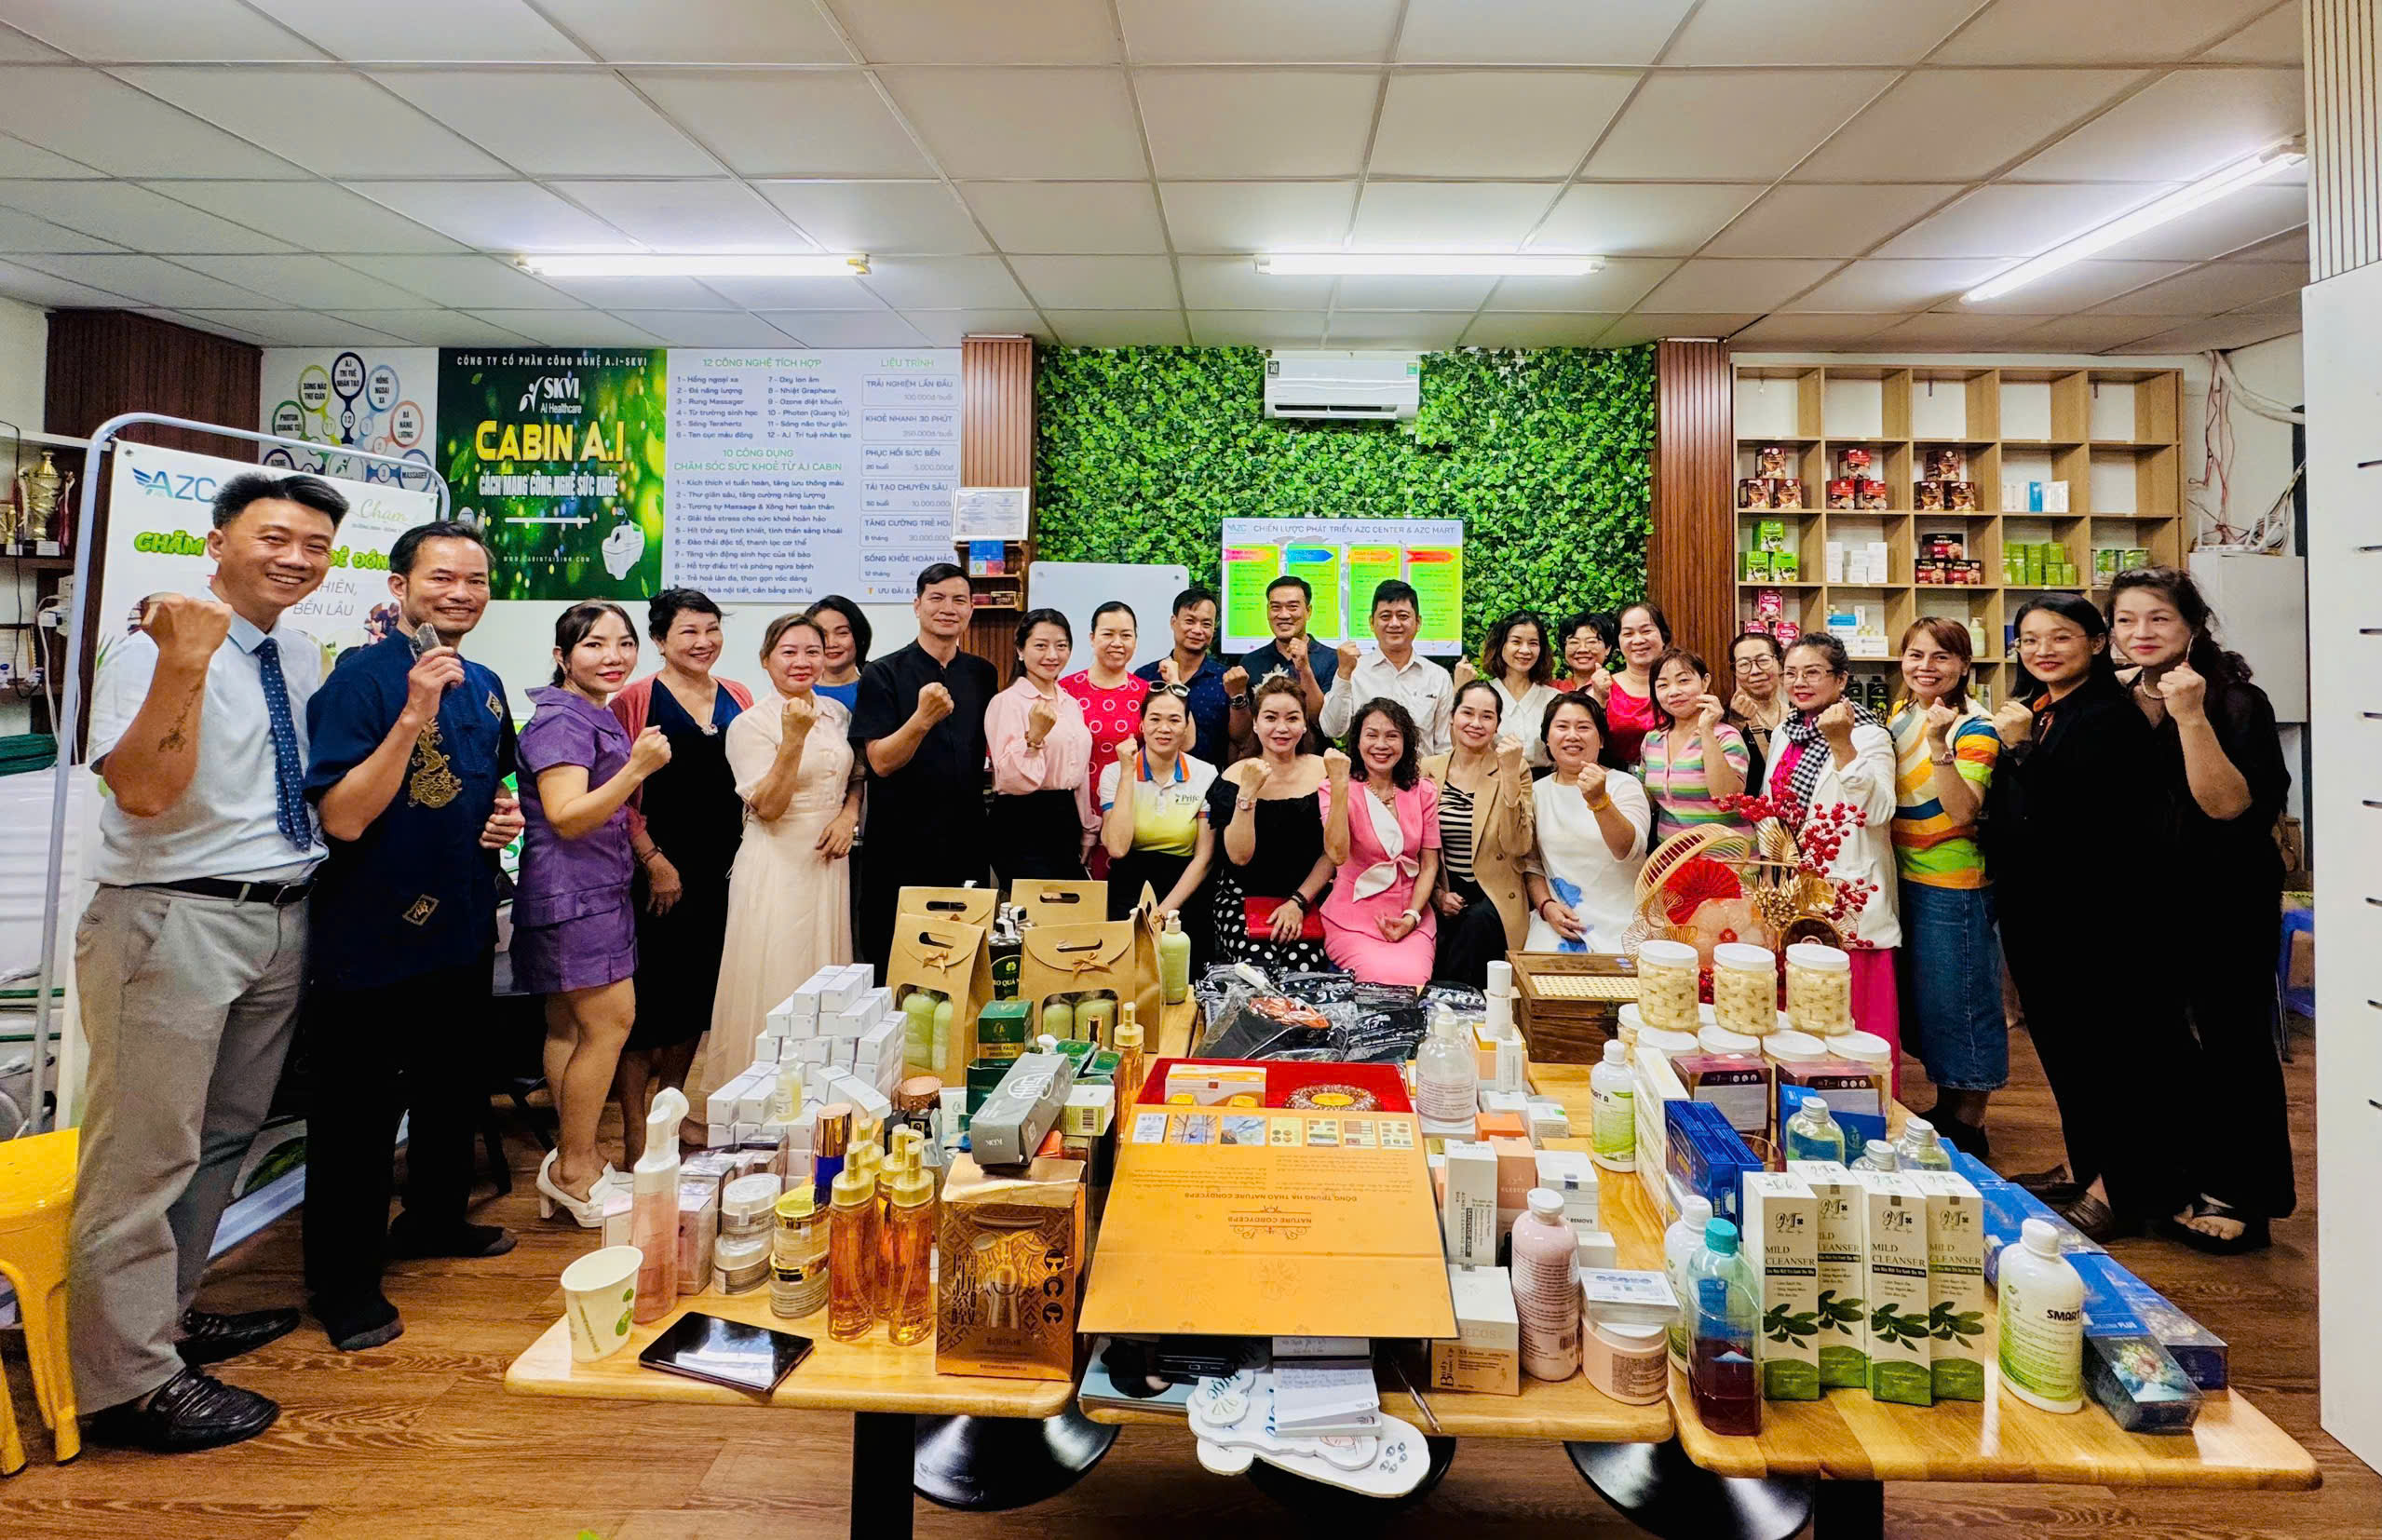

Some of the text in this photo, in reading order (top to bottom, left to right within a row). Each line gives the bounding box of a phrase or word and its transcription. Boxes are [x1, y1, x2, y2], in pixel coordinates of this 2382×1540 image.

[457, 355, 482, 365] CÔNG
[487, 356, 497, 365] TY
[548, 355, 573, 365] CÔNG
[577, 355, 601, 368] NGHỆ
[715, 358, 742, 366] CÔNG
[745, 358, 772, 369] NGHỆ
[776, 358, 797, 366] TÍCH
[800, 358, 821, 369] HỢP
[881, 358, 934, 368] LIỆU TRÌNH
[544, 378, 579, 399] SKVI
[541, 403, 582, 414] AI Healthcare
[476, 421, 625, 462] CABIN A.I
[736, 449, 764, 457] CÔNG
[769, 451, 793, 459] DỤNG
[866, 450, 887, 458] PHỤC
[674, 462, 702, 470] CHĂM
[705, 462, 724, 470] SÓC
[728, 462, 749, 470] SỨC
[133, 468, 216, 503] AZC
[480, 470, 501, 496] CÁCH
[530, 470, 552, 496] CÔNG
[577, 471, 594, 496] SỨC
[880, 484, 896, 493] TẠO
[898, 482, 929, 491] CHUYÊN
[932, 482, 948, 491] SÂU
[1253, 522, 1279, 533] CHIẾN
[1280, 524, 1305, 535] LƯỢC
[1306, 523, 1326, 534] PHÁT
[1330, 521, 1352, 534] TRIỂN
[133, 530, 207, 558] CHĂM
[320, 579, 357, 596] HIÊN,
[327, 600, 354, 616] LÂU
[1819, 1232, 1834, 1240] ILD
[1818, 1244, 1860, 1252] LEANSER
[1872, 1244, 1898, 1252] MILD
[1766, 1258, 1815, 1266] CLEANSER
[1872, 1255, 1925, 1266] CLEANSER
[1929, 1255, 1982, 1265] CLEANSER
[2047, 1309, 2080, 1322] SMART
